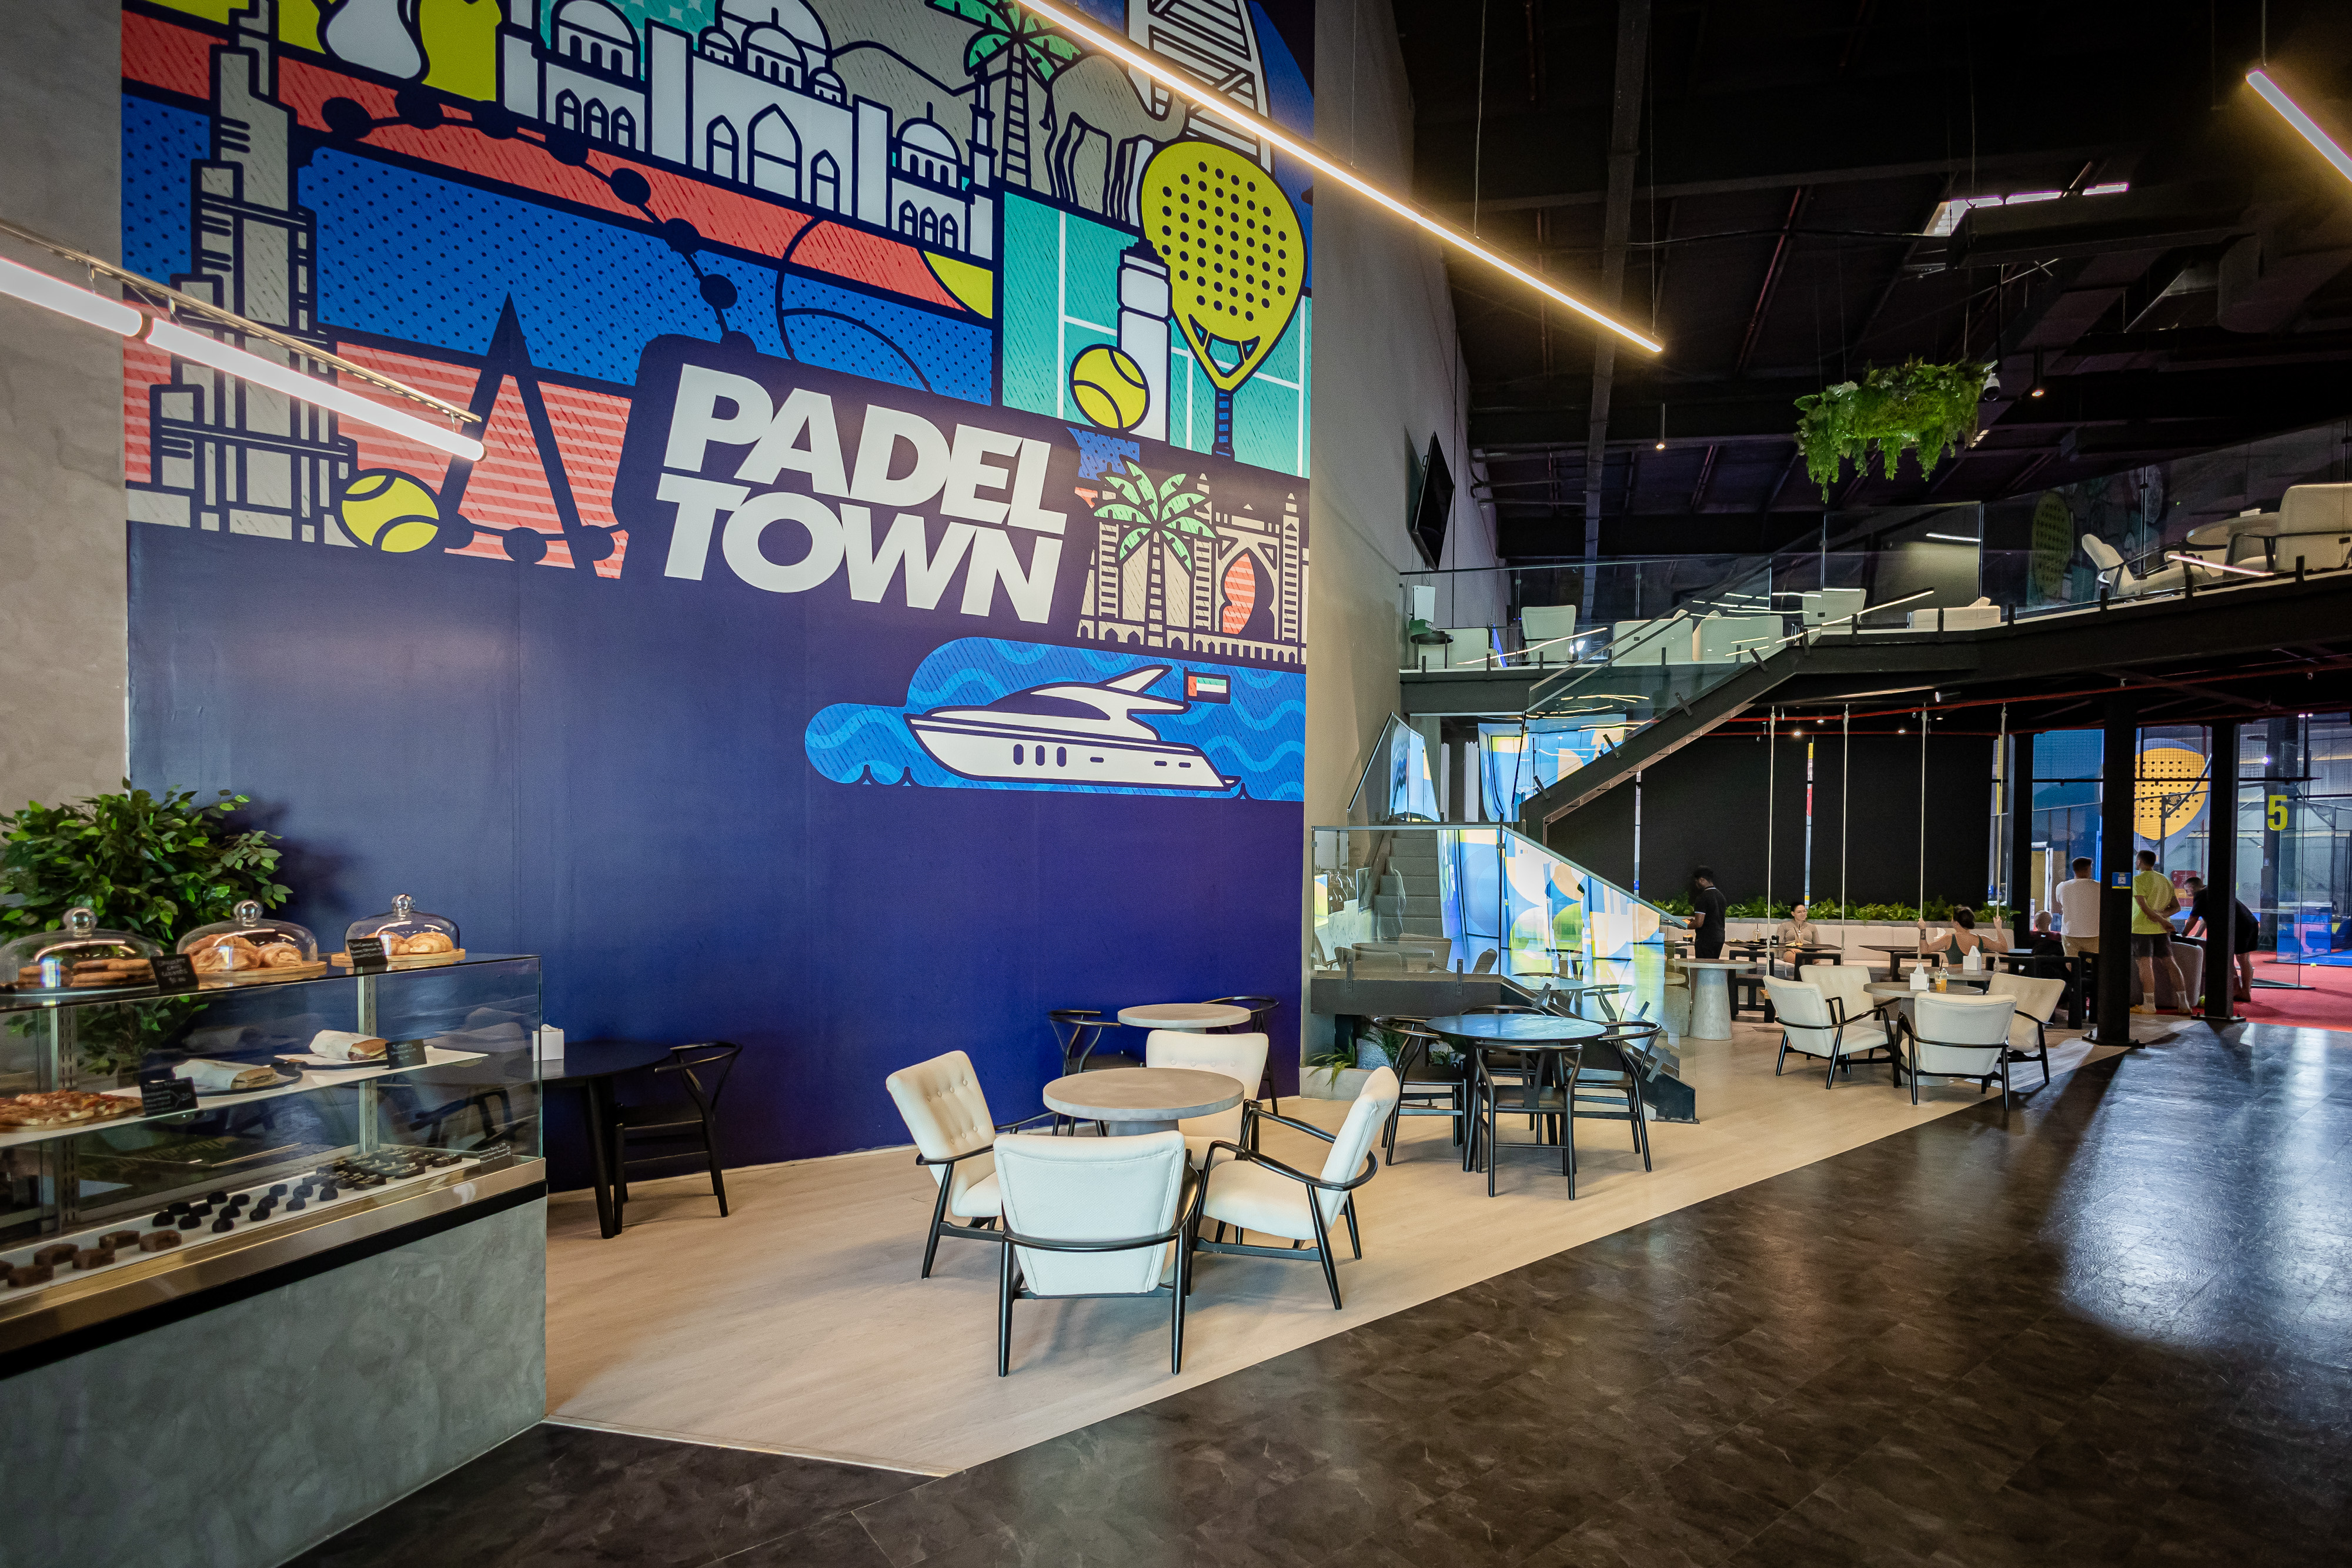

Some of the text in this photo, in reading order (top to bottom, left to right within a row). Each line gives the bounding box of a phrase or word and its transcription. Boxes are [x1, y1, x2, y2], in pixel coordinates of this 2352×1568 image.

[664, 363, 1067, 535] PADEL
[656, 473, 1063, 624] TOWN
[2267, 795, 2288, 831] 5
